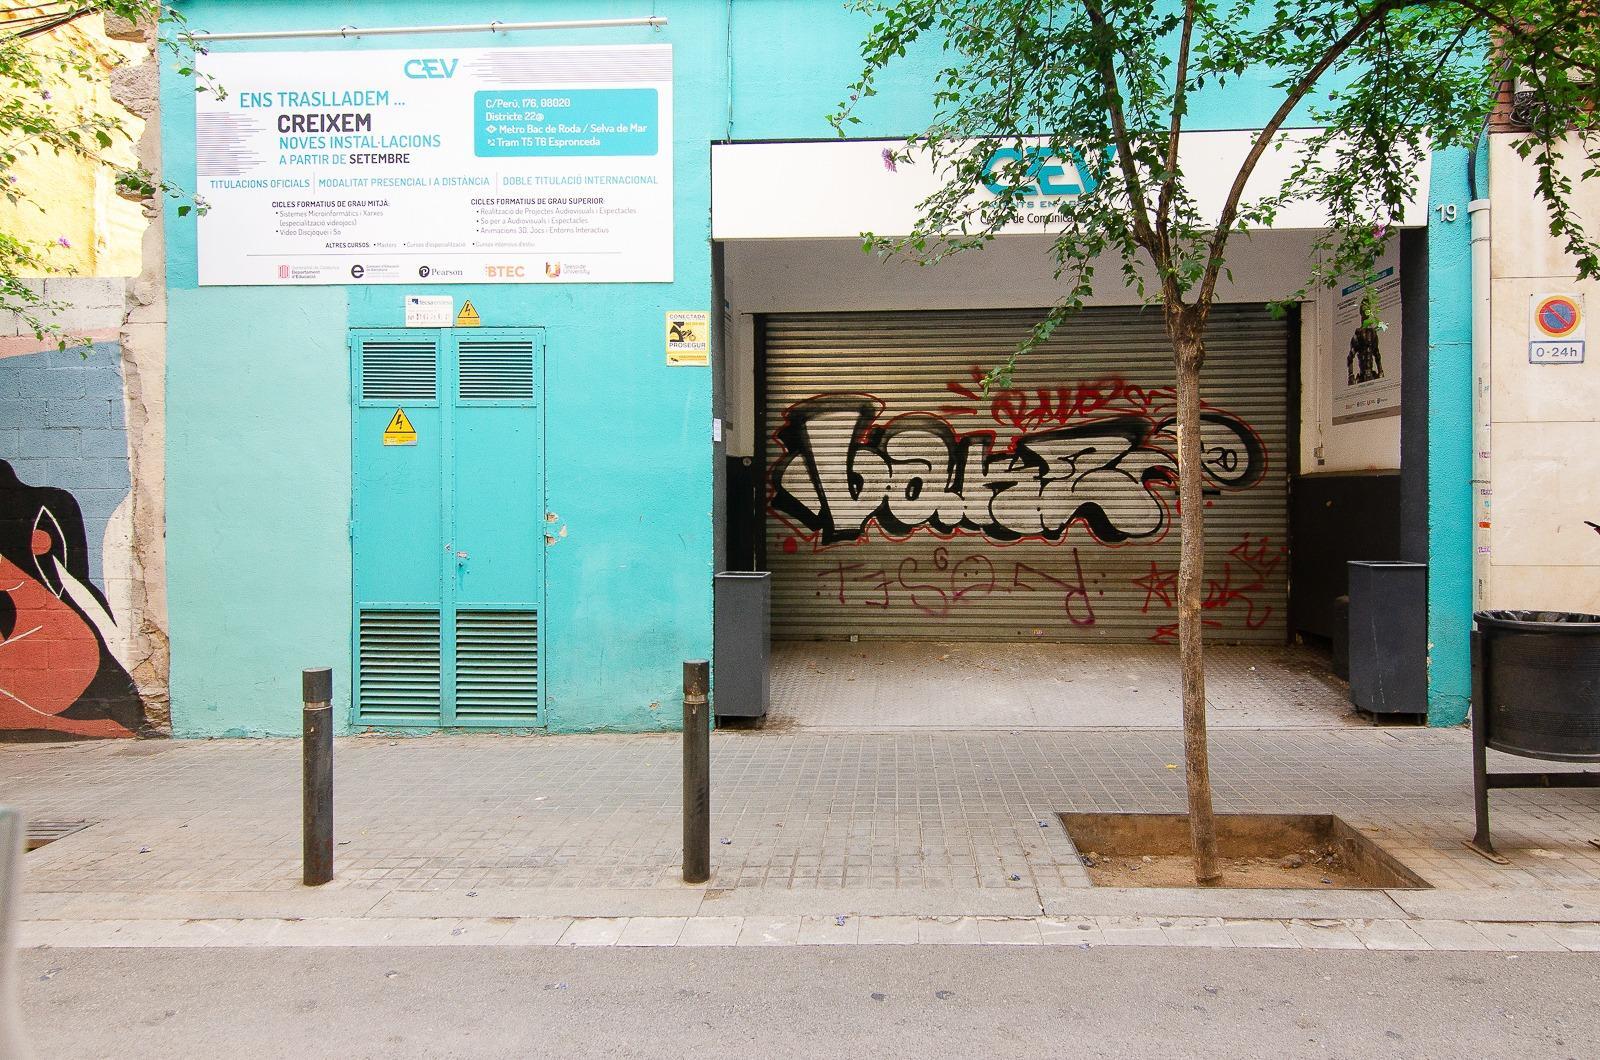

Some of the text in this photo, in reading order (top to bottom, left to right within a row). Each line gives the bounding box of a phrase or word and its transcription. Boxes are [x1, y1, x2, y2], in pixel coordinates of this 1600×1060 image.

[404, 58, 459, 80] CEV
[240, 92, 273, 108] ENS
[278, 91, 390, 108] TRASLLADEM
[485, 112, 545, 122] Districte 22@
[278, 113, 372, 134] CREIXEM
[500, 125, 525, 134] Metro
[527, 125, 544, 134] Bac
[545, 124, 557, 133] de
[558, 124, 582, 133] Roda
[591, 124, 615, 133] Selva
[617, 124, 628, 132] de
[630, 123, 648, 132] Mar
[279, 136, 326, 150] NOVES
[498, 138, 520, 147] Tram
[521, 137, 533, 147] T5
[548, 137, 601, 148] Espronceda
[279, 153, 411, 166] A PARTIR DE SETEMBRE
[210, 179, 310, 189] TITULACIONS OFICIALS
[319, 178, 368, 188] MODALITAT
[371, 178, 426, 187] PRESENCIAL
[434, 177, 440, 187] A
[503, 177, 533, 186] DOBLE
[584, 176, 658, 185] INTERNACIONAL
[297, 200, 336, 208] FORMATIUS
[337, 200, 346, 208] DE
[525, 208, 554, 216] Projectes
[555, 207, 595, 215] Audiovisuals
[599, 207, 637, 215] Espectacles
[1436, 203, 1457, 223] 19
[552, 217, 589, 225] Espectacles
[431, 268, 464, 276] Pearson
[487, 266, 525, 278] BTEC
